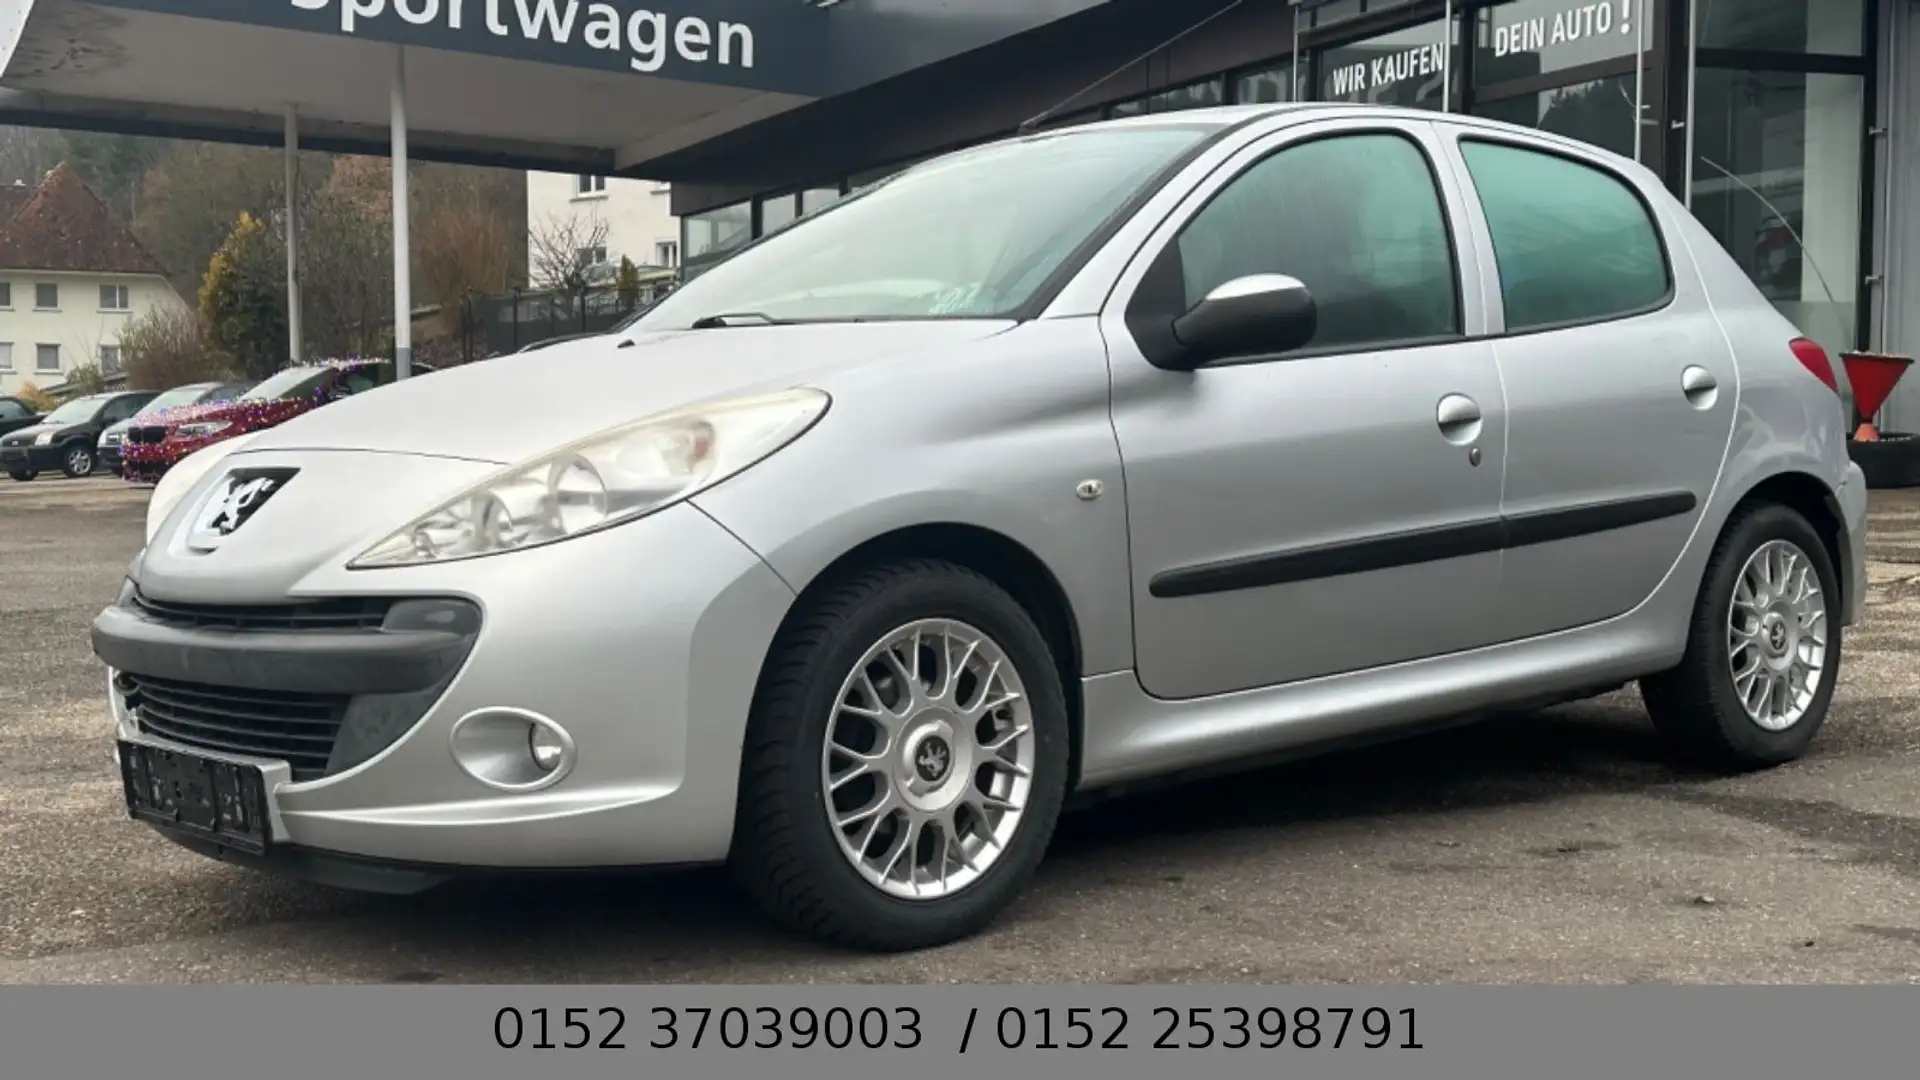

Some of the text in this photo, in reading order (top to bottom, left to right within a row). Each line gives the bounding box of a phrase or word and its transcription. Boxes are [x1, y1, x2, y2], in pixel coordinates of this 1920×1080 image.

[291, 0, 753, 71] portwagen
[1495, 17, 1545, 58] DEIN
[1551, 1, 1612, 45] AUTO
[1333, 41, 1444, 95] WIR KAUFEN
